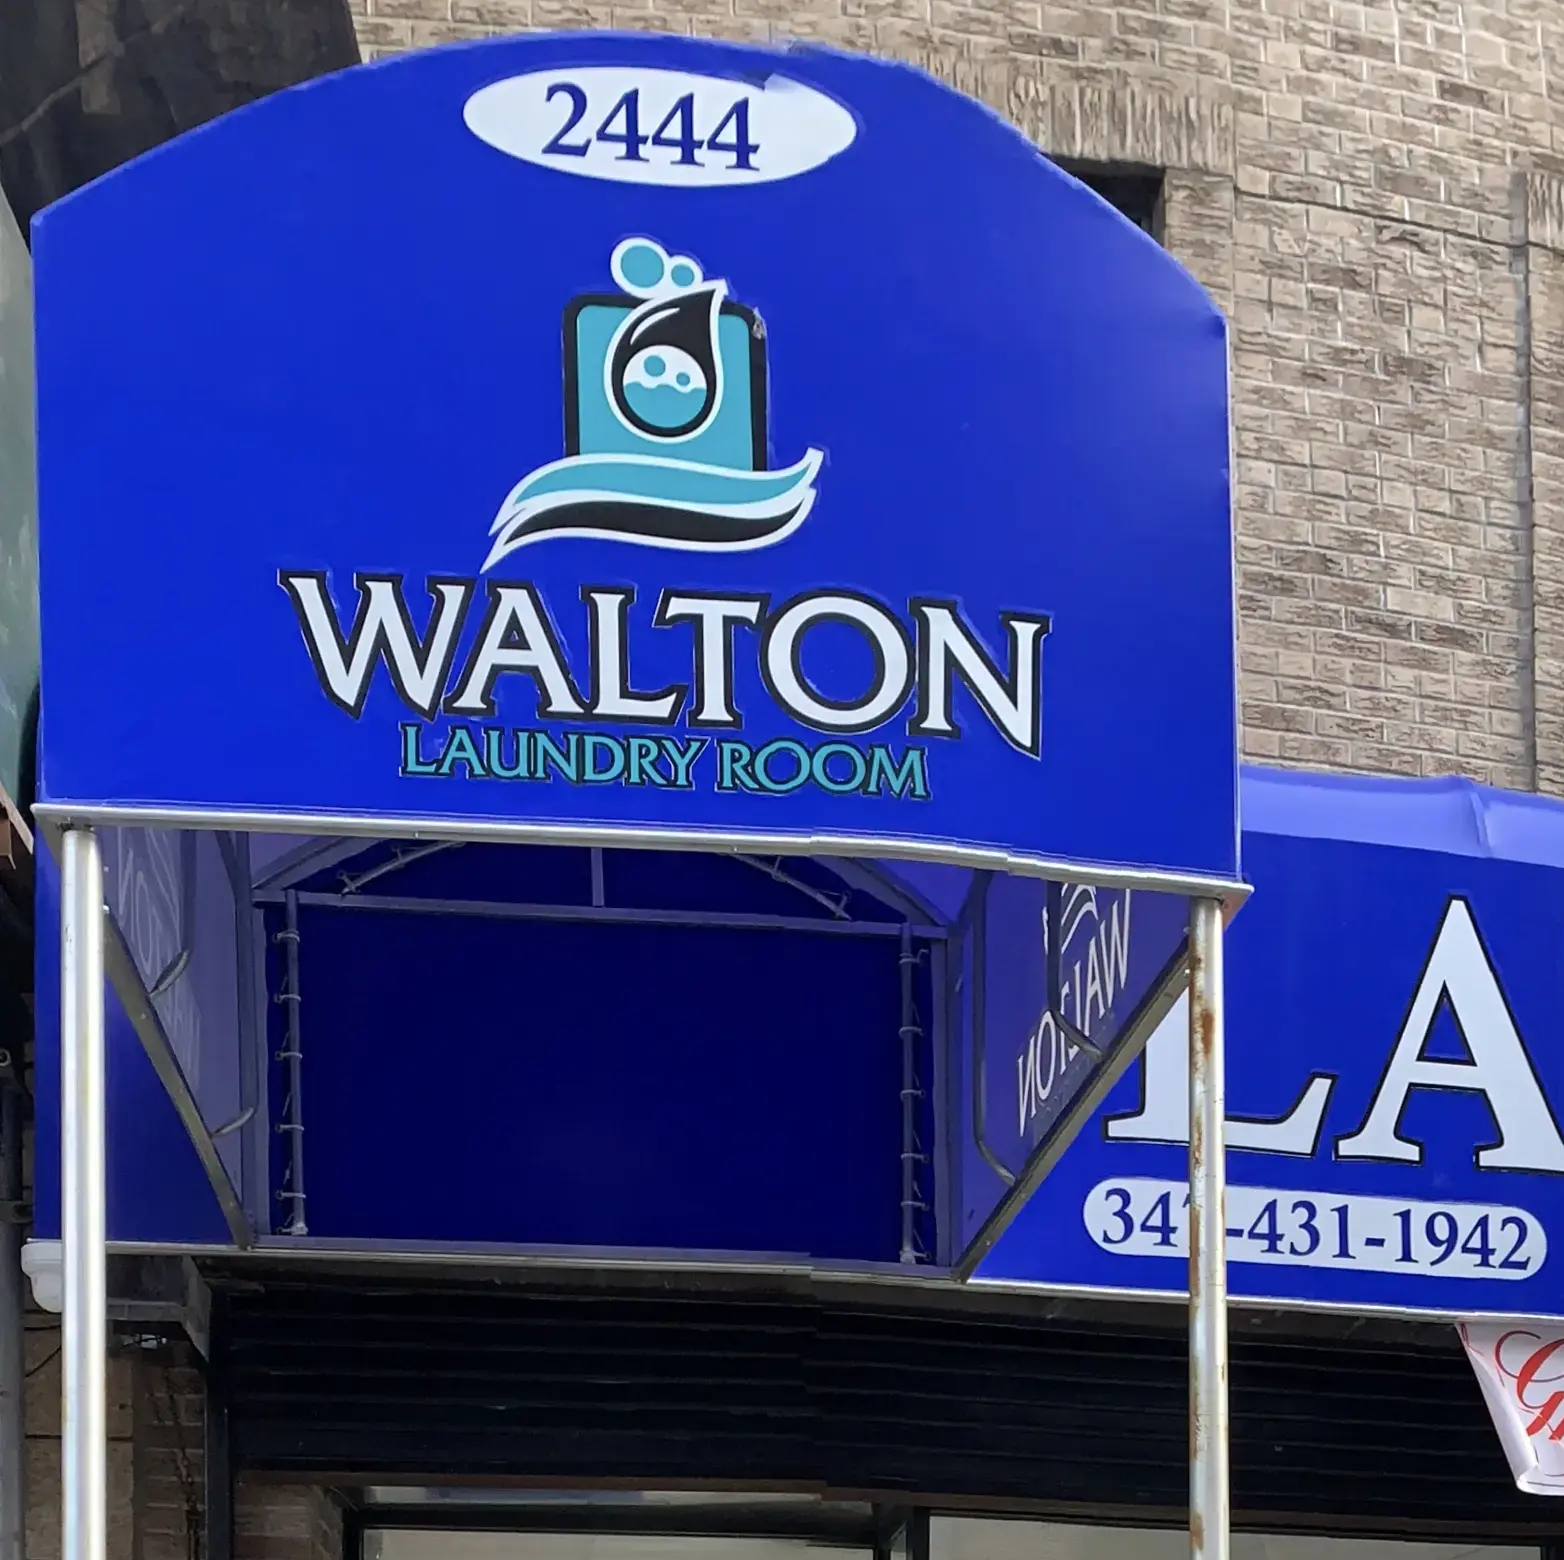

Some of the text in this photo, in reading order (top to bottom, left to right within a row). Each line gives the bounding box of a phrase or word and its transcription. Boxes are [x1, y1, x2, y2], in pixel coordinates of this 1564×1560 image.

[543, 83, 760, 172] 2444
[279, 570, 1051, 760] WALTON
[402, 722, 931, 801] LAUNDRY ROOM
[1100, 1188, 1532, 1272] 34-431-1942
